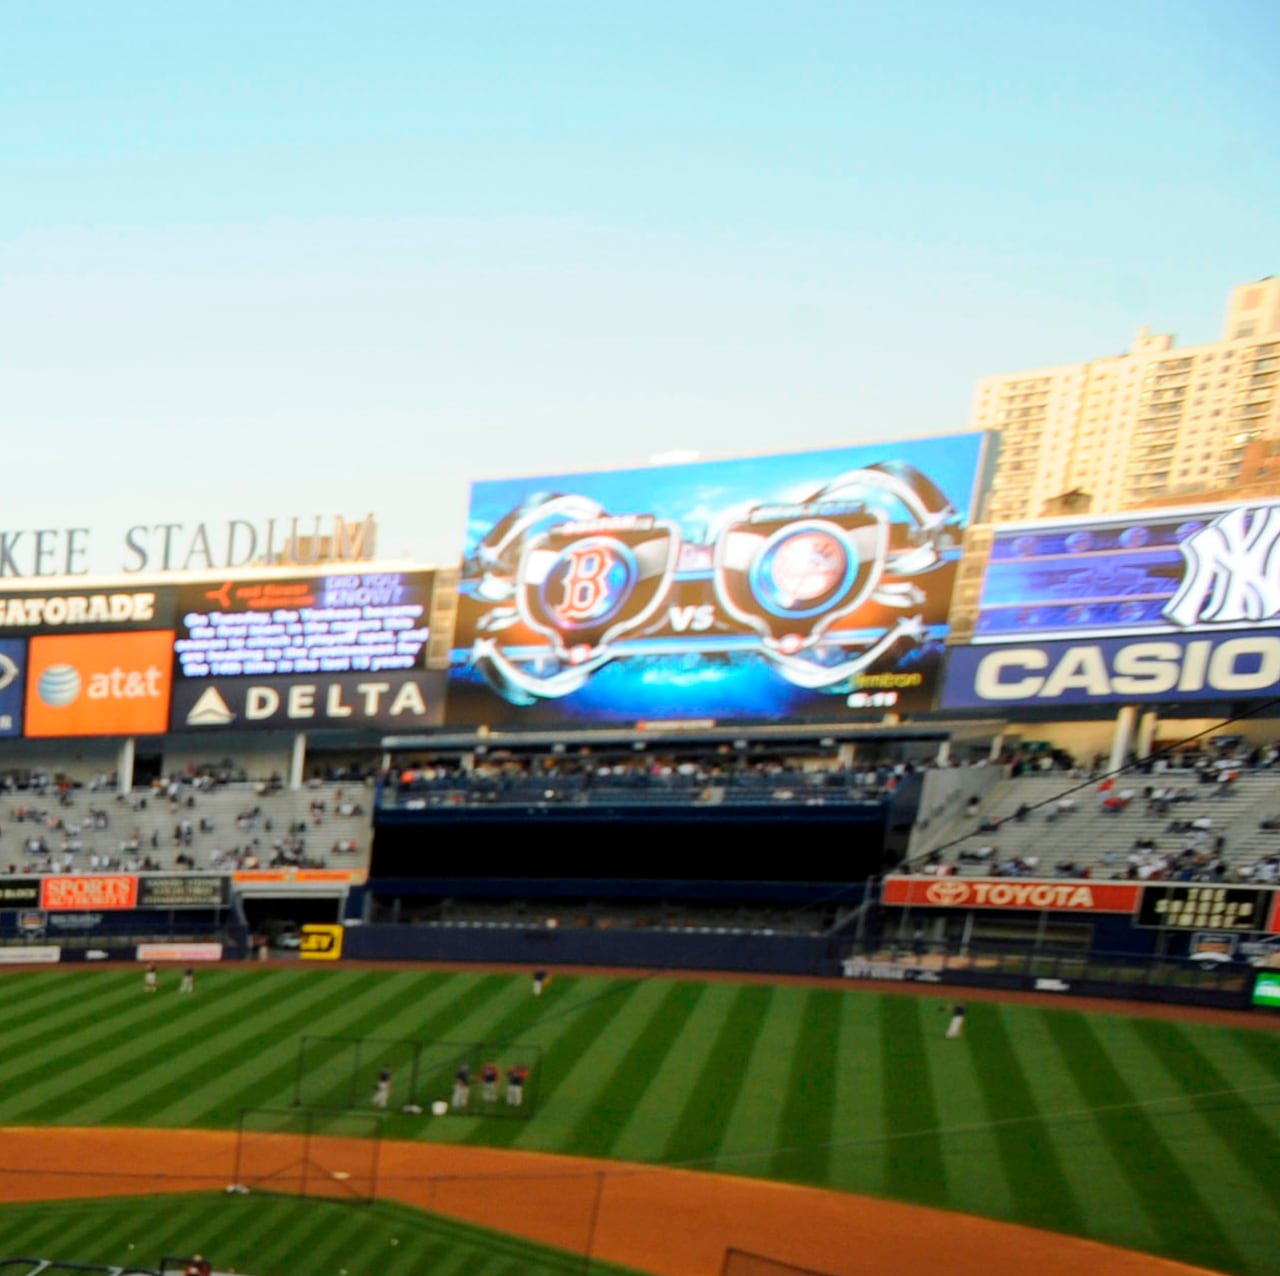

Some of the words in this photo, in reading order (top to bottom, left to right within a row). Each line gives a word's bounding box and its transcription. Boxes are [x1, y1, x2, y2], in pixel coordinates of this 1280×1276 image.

[122, 513, 378, 574] STADIUM
[668, 606, 716, 632] VS
[87, 666, 164, 700] at&t
[974, 635, 1280, 700] CASIO
[245, 681, 427, 720] DELTA
[46, 878, 131, 897] SPORTS
[973, 883, 1094, 907] TOYOTA
